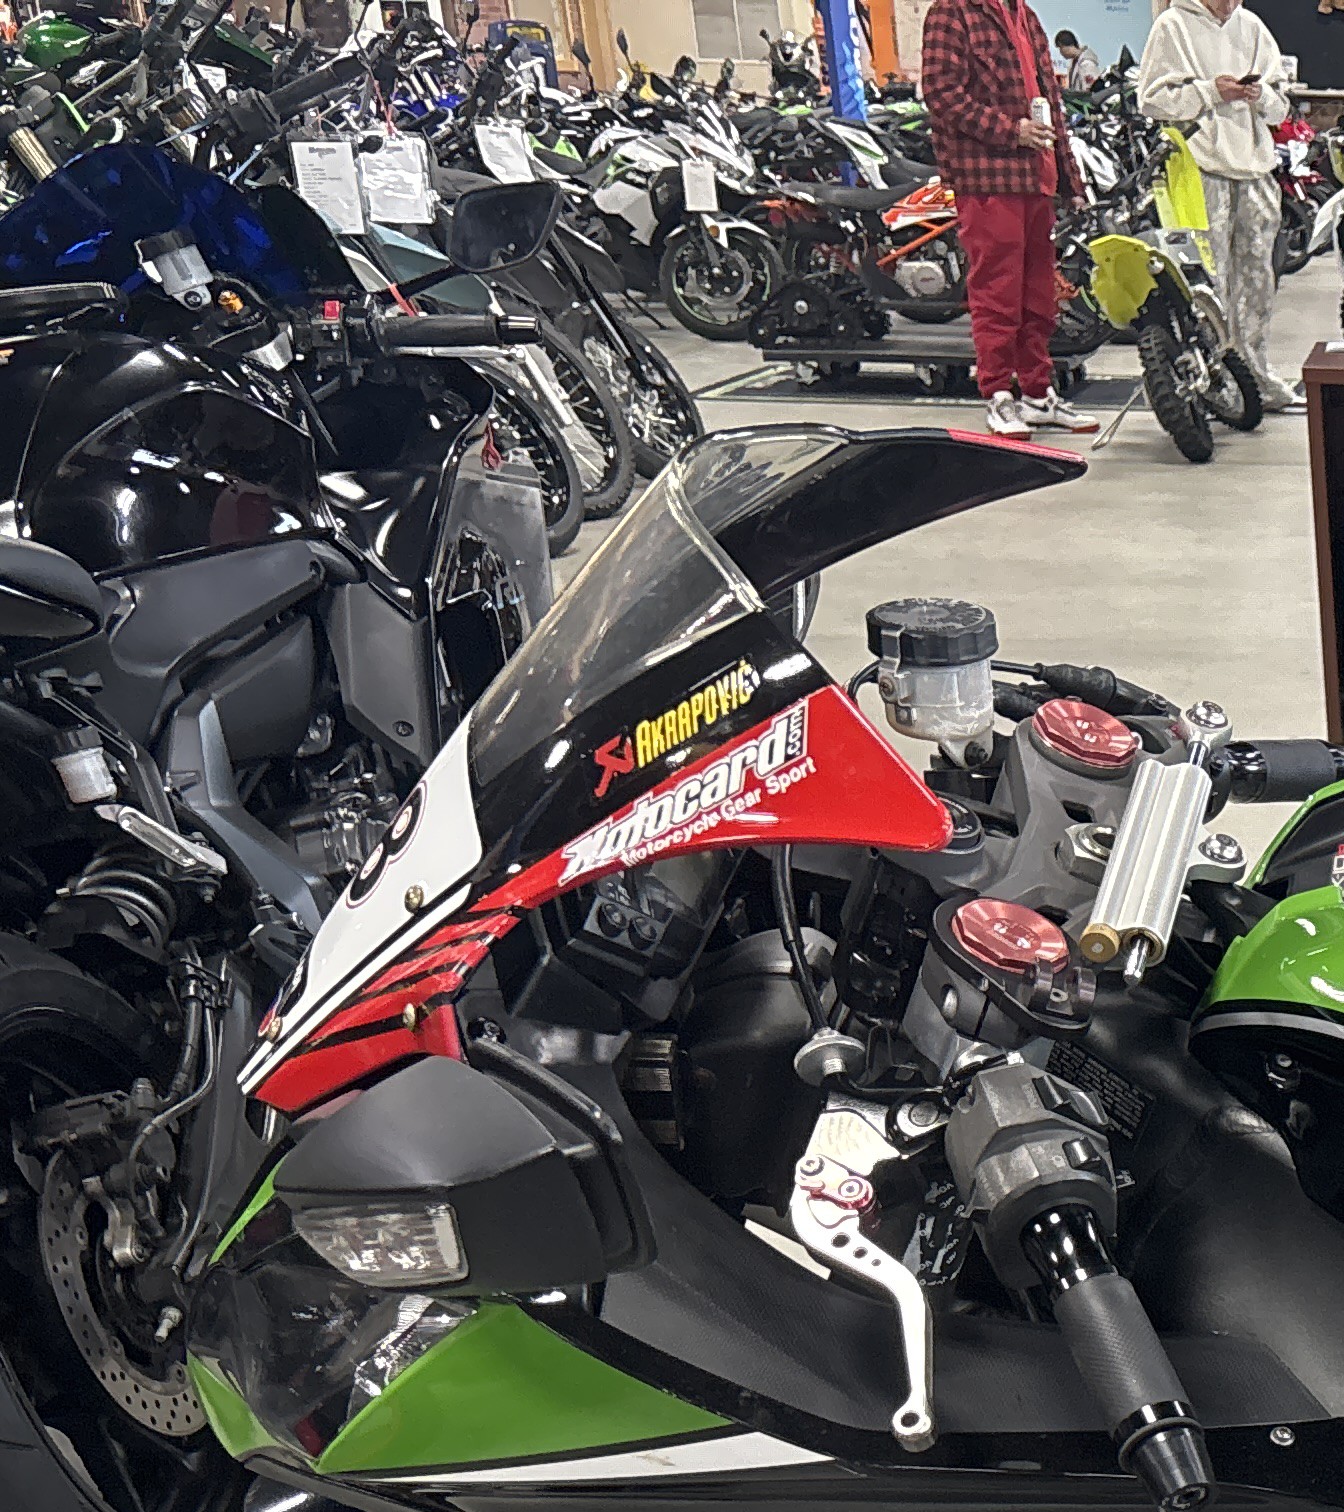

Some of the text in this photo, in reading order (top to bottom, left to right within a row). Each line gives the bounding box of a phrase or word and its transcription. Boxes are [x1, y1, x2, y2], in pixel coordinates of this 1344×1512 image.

[558, 714, 790, 887] Motocard
[619, 757, 817, 868] Motorcycle Gear Sport
